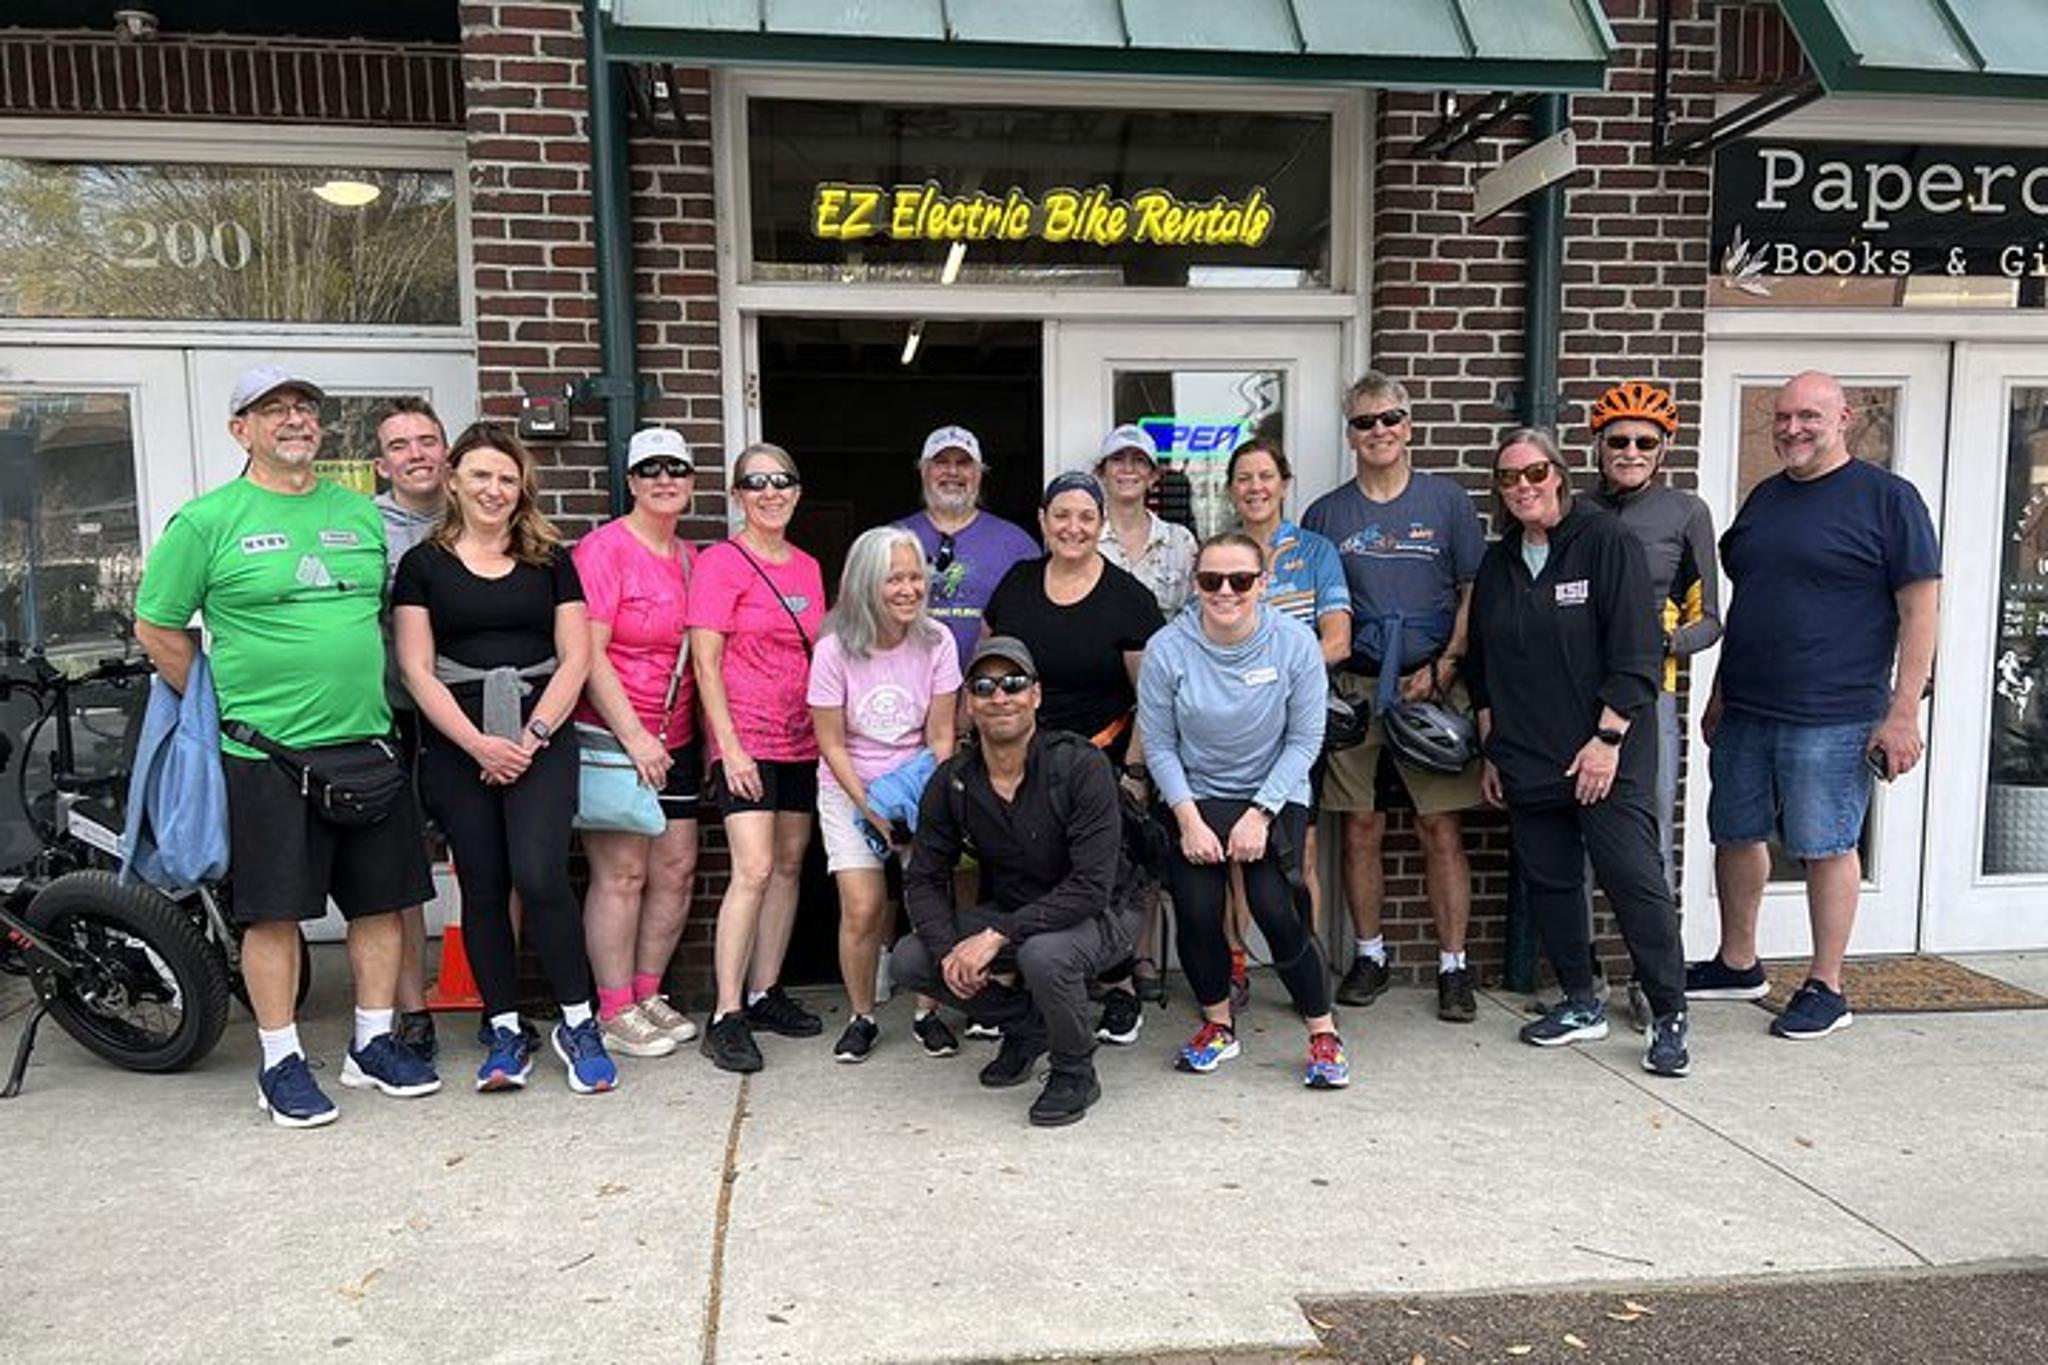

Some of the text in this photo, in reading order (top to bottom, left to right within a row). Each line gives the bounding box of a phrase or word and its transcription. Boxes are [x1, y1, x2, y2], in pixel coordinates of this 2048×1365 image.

[816, 185, 1271, 246] EZ Electric Bike Rentals
[100, 217, 251, 271] 200
[1773, 241, 2048, 276] Books & Gi
[1146, 423, 1241, 452] PEN
